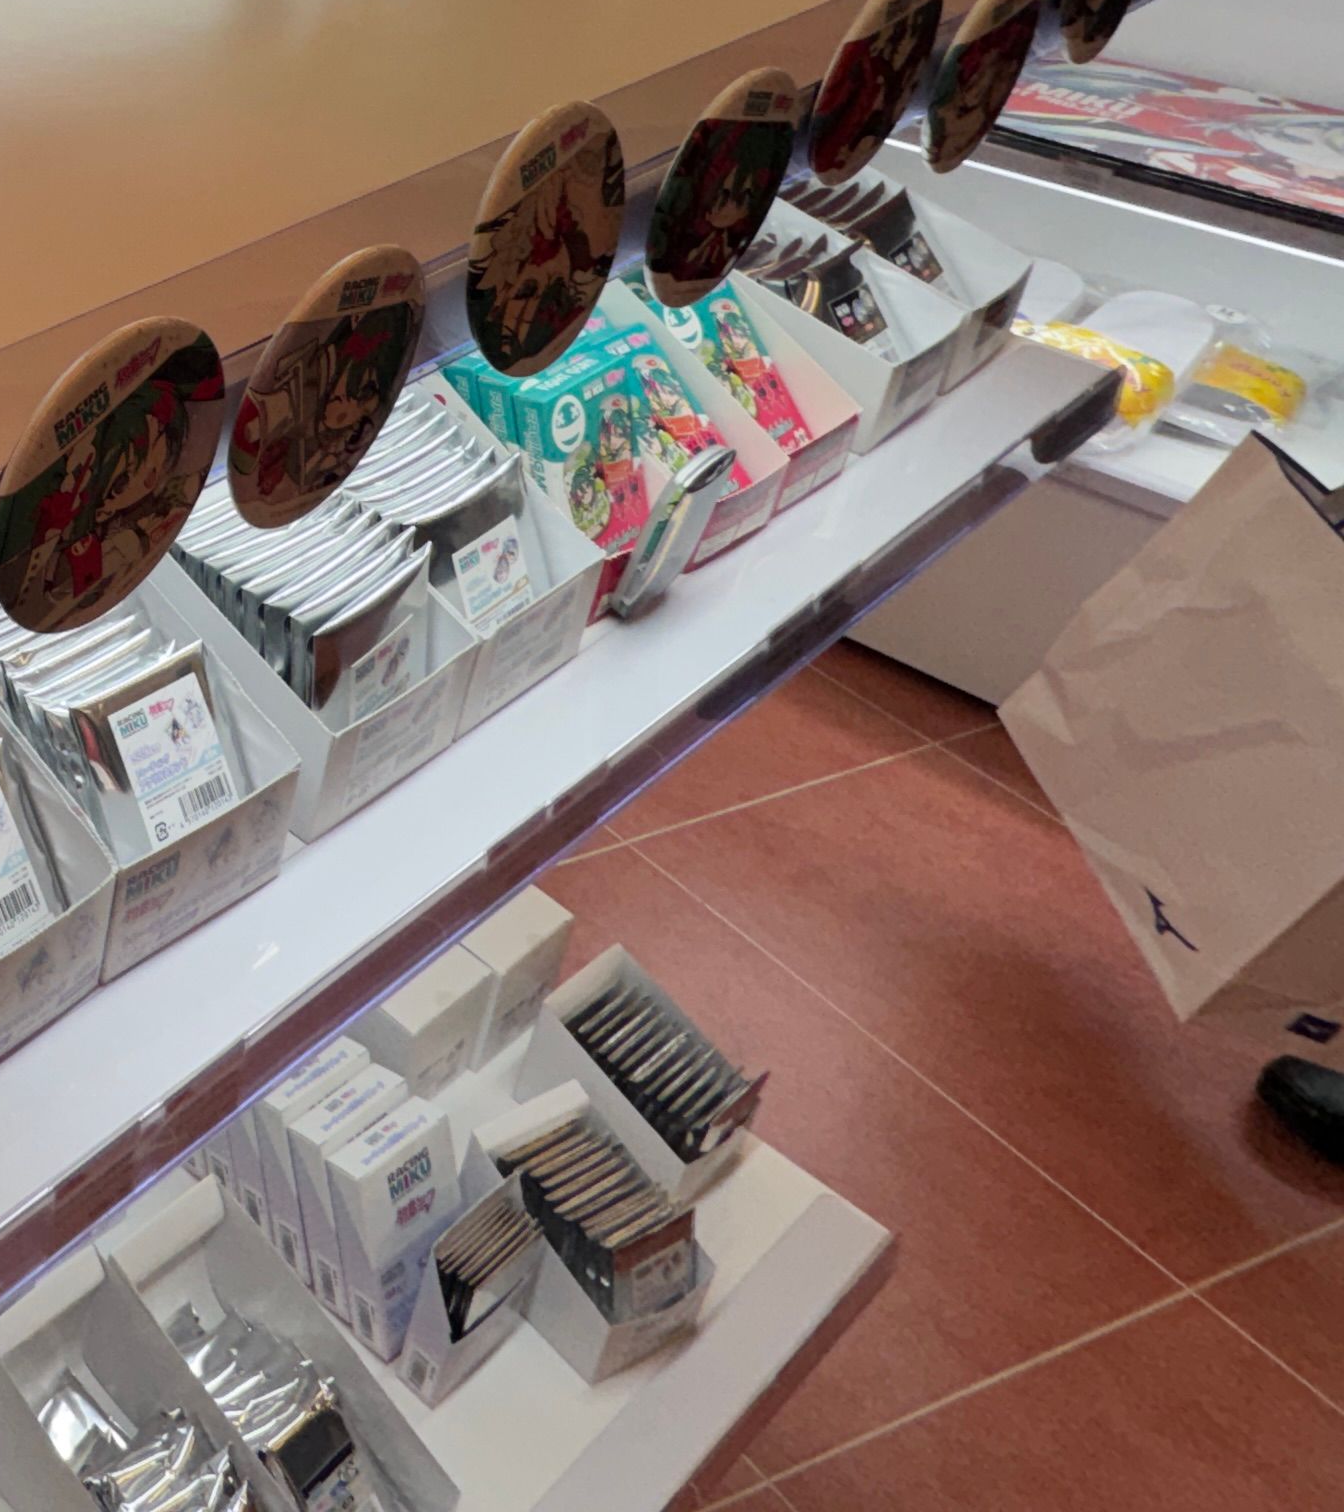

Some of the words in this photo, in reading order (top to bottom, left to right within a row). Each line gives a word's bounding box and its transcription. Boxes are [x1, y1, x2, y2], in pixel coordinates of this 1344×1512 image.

[54, 381, 108, 432] RACING
[55, 389, 111, 449] MIKU
[118, 714, 148, 735] MIKU
[387, 1146, 430, 1185] RACING
[389, 1157, 432, 1200] MIKU
